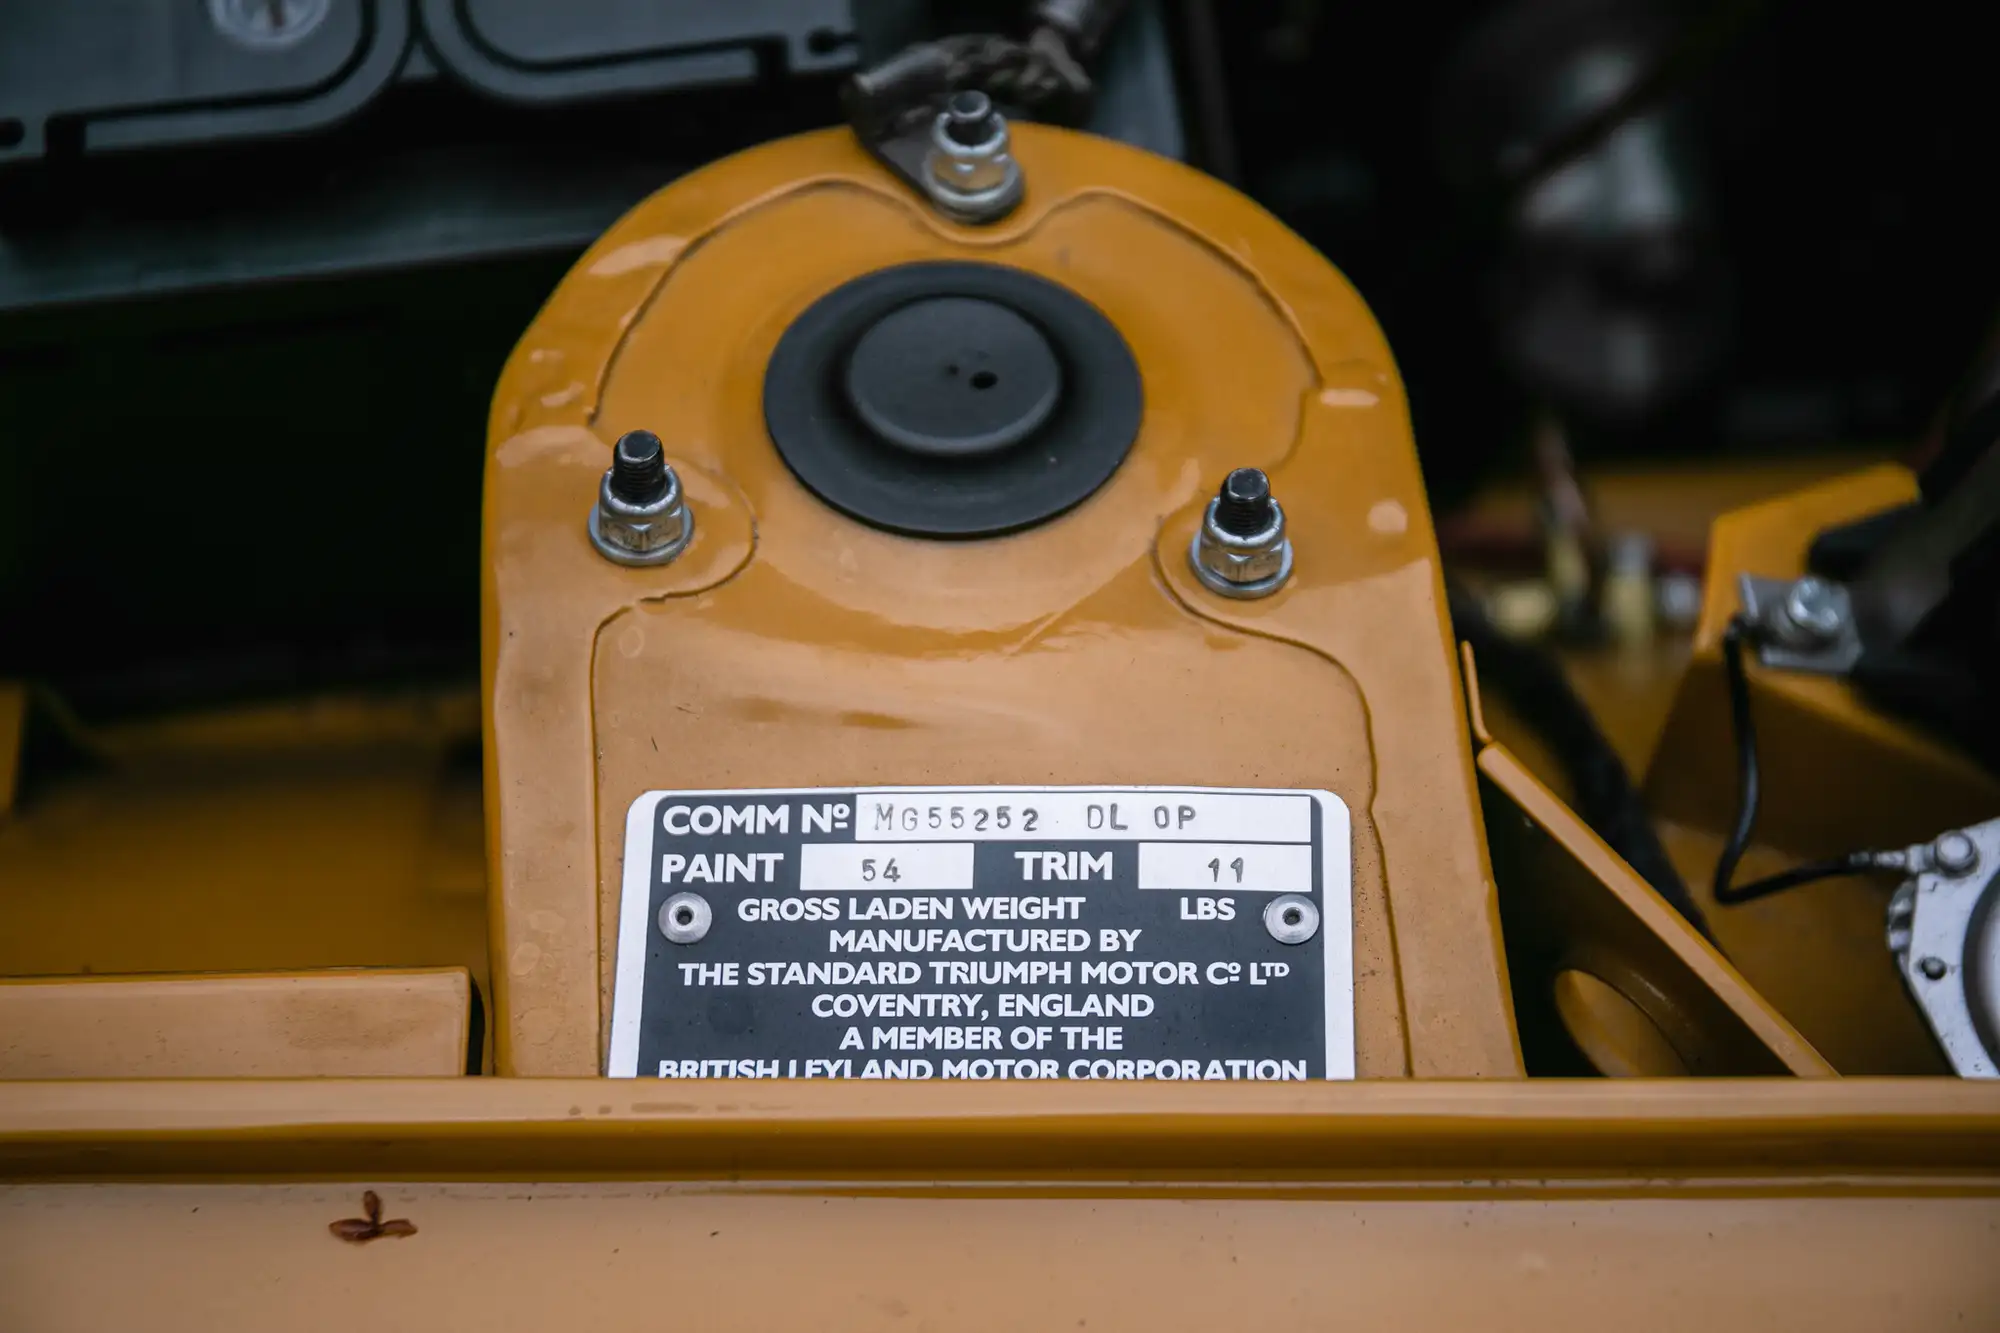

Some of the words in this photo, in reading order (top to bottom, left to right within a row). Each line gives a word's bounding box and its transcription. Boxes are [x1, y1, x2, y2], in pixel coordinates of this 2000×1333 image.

[663, 805, 789, 834] COMM
[874, 803, 1038, 831] MG55252
[1088, 804, 1127, 829] DL
[662, 853, 784, 883] PAINT
[863, 859, 900, 882] 54
[1016, 852, 1111, 880] TRIM
[1208, 858, 1243, 882] 11
[738, 898, 840, 921] GROSS
[849, 897, 953, 920] LADEN
[961, 897, 1086, 919] WEIGHT
[1181, 897, 1235, 920] LBS
[830, 929, 1091, 952] MANUFACTURED
[1100, 929, 1142, 951] BY
[678, 963, 739, 985] THE
[748, 962, 921, 985] STANDARD
[929, 962, 1071, 984] TRIUMPH
[1081, 961, 1199, 984] MOTOR
[812, 994, 988, 1021] COVENTRY,
[999, 994, 1154, 1017] ENGLAND
[839, 1027, 864, 1049] A
[873, 1027, 1003, 1049] MEMBER
[1011, 1026, 1052, 1050] OF
[1060, 1027, 1122, 1050] THE
[659, 1060, 779, 1078] BRITISH
[942, 1059, 1059, 1079] MOTOR
[1069, 1059, 1306, 1080] CORPORATION
